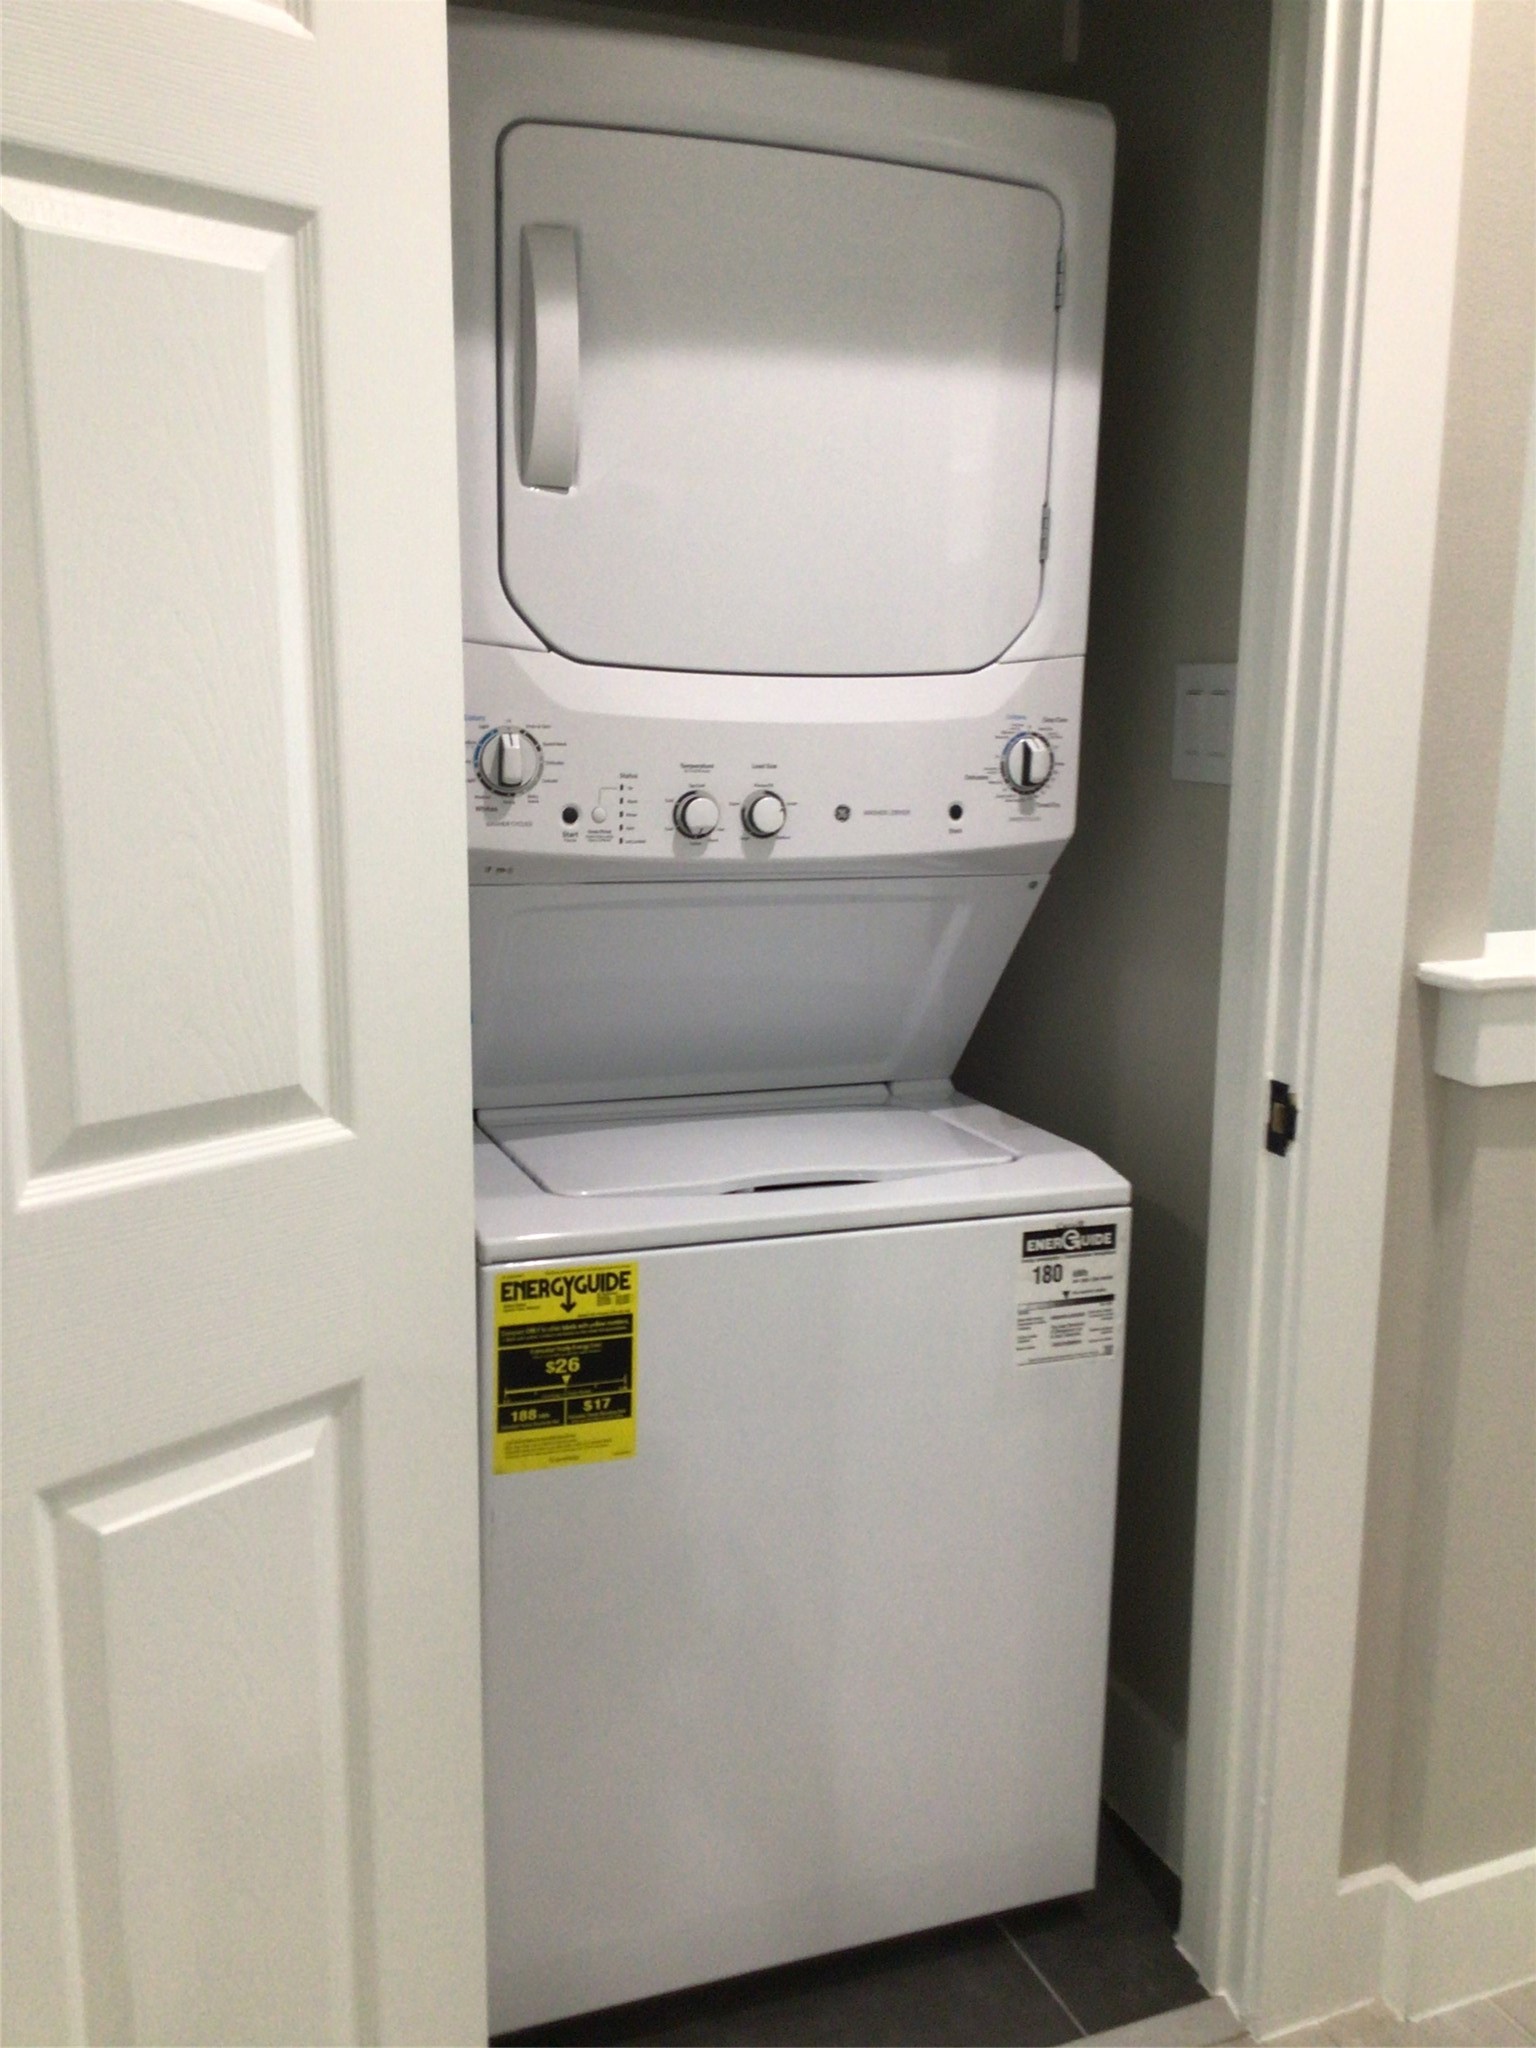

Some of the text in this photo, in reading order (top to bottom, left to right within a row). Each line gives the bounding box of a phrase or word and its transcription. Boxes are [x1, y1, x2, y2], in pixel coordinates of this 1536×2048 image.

[1026, 1229, 1112, 1252] ENERGUIDE
[1032, 1264, 1063, 1284] 180
[501, 1270, 632, 1303] ENERGYGUIDE
[545, 1356, 581, 1375] $26
[583, 1398, 611, 1412] $17
